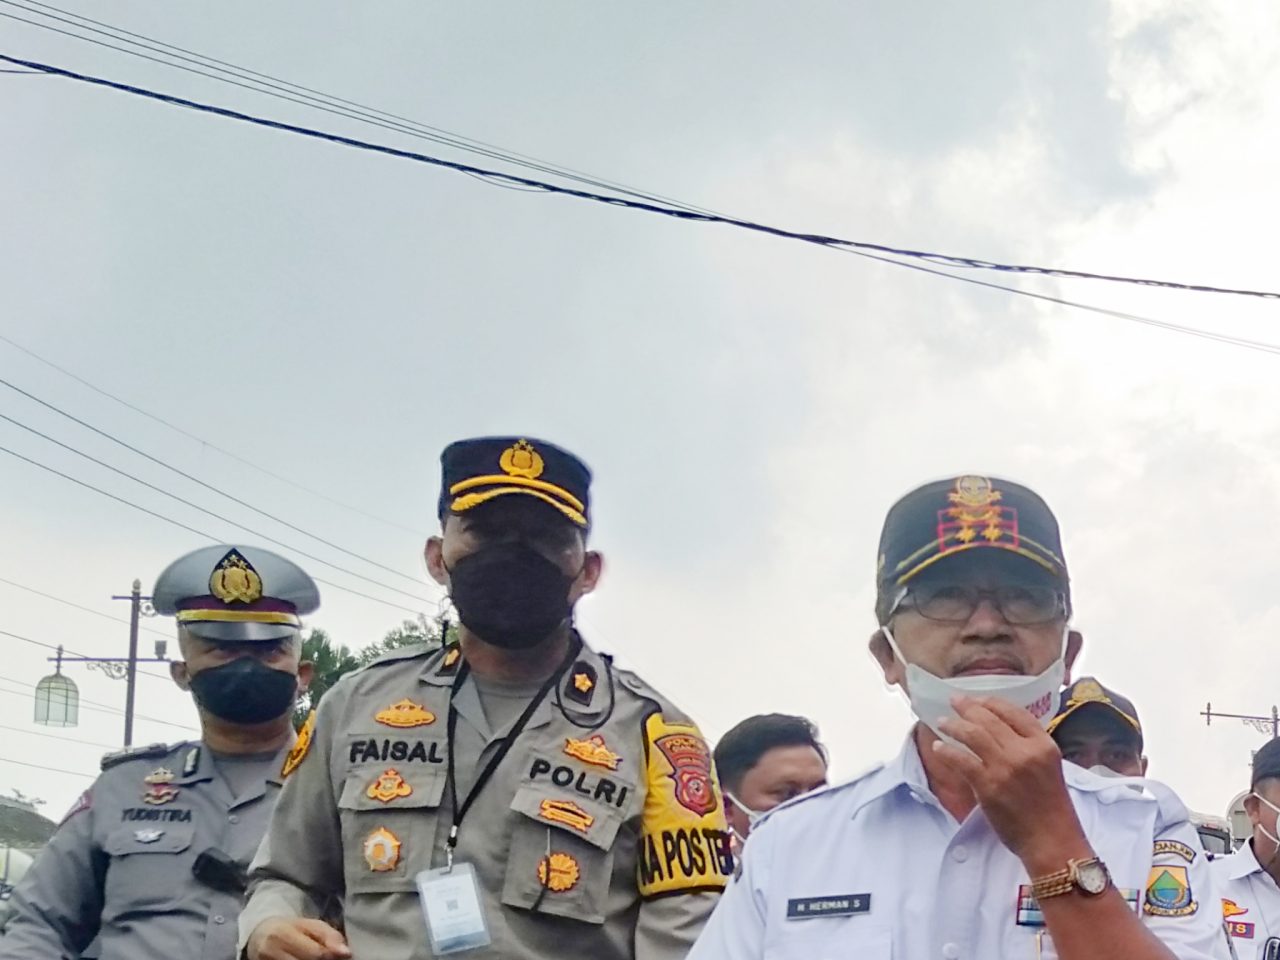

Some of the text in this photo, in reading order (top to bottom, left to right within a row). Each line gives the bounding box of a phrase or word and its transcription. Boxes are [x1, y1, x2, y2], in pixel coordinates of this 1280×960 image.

[350, 739, 443, 764] FAISAL
[529, 758, 627, 808] POLRI
[662, 828, 706, 879] POS
[809, 900, 849, 911] HERMAN
